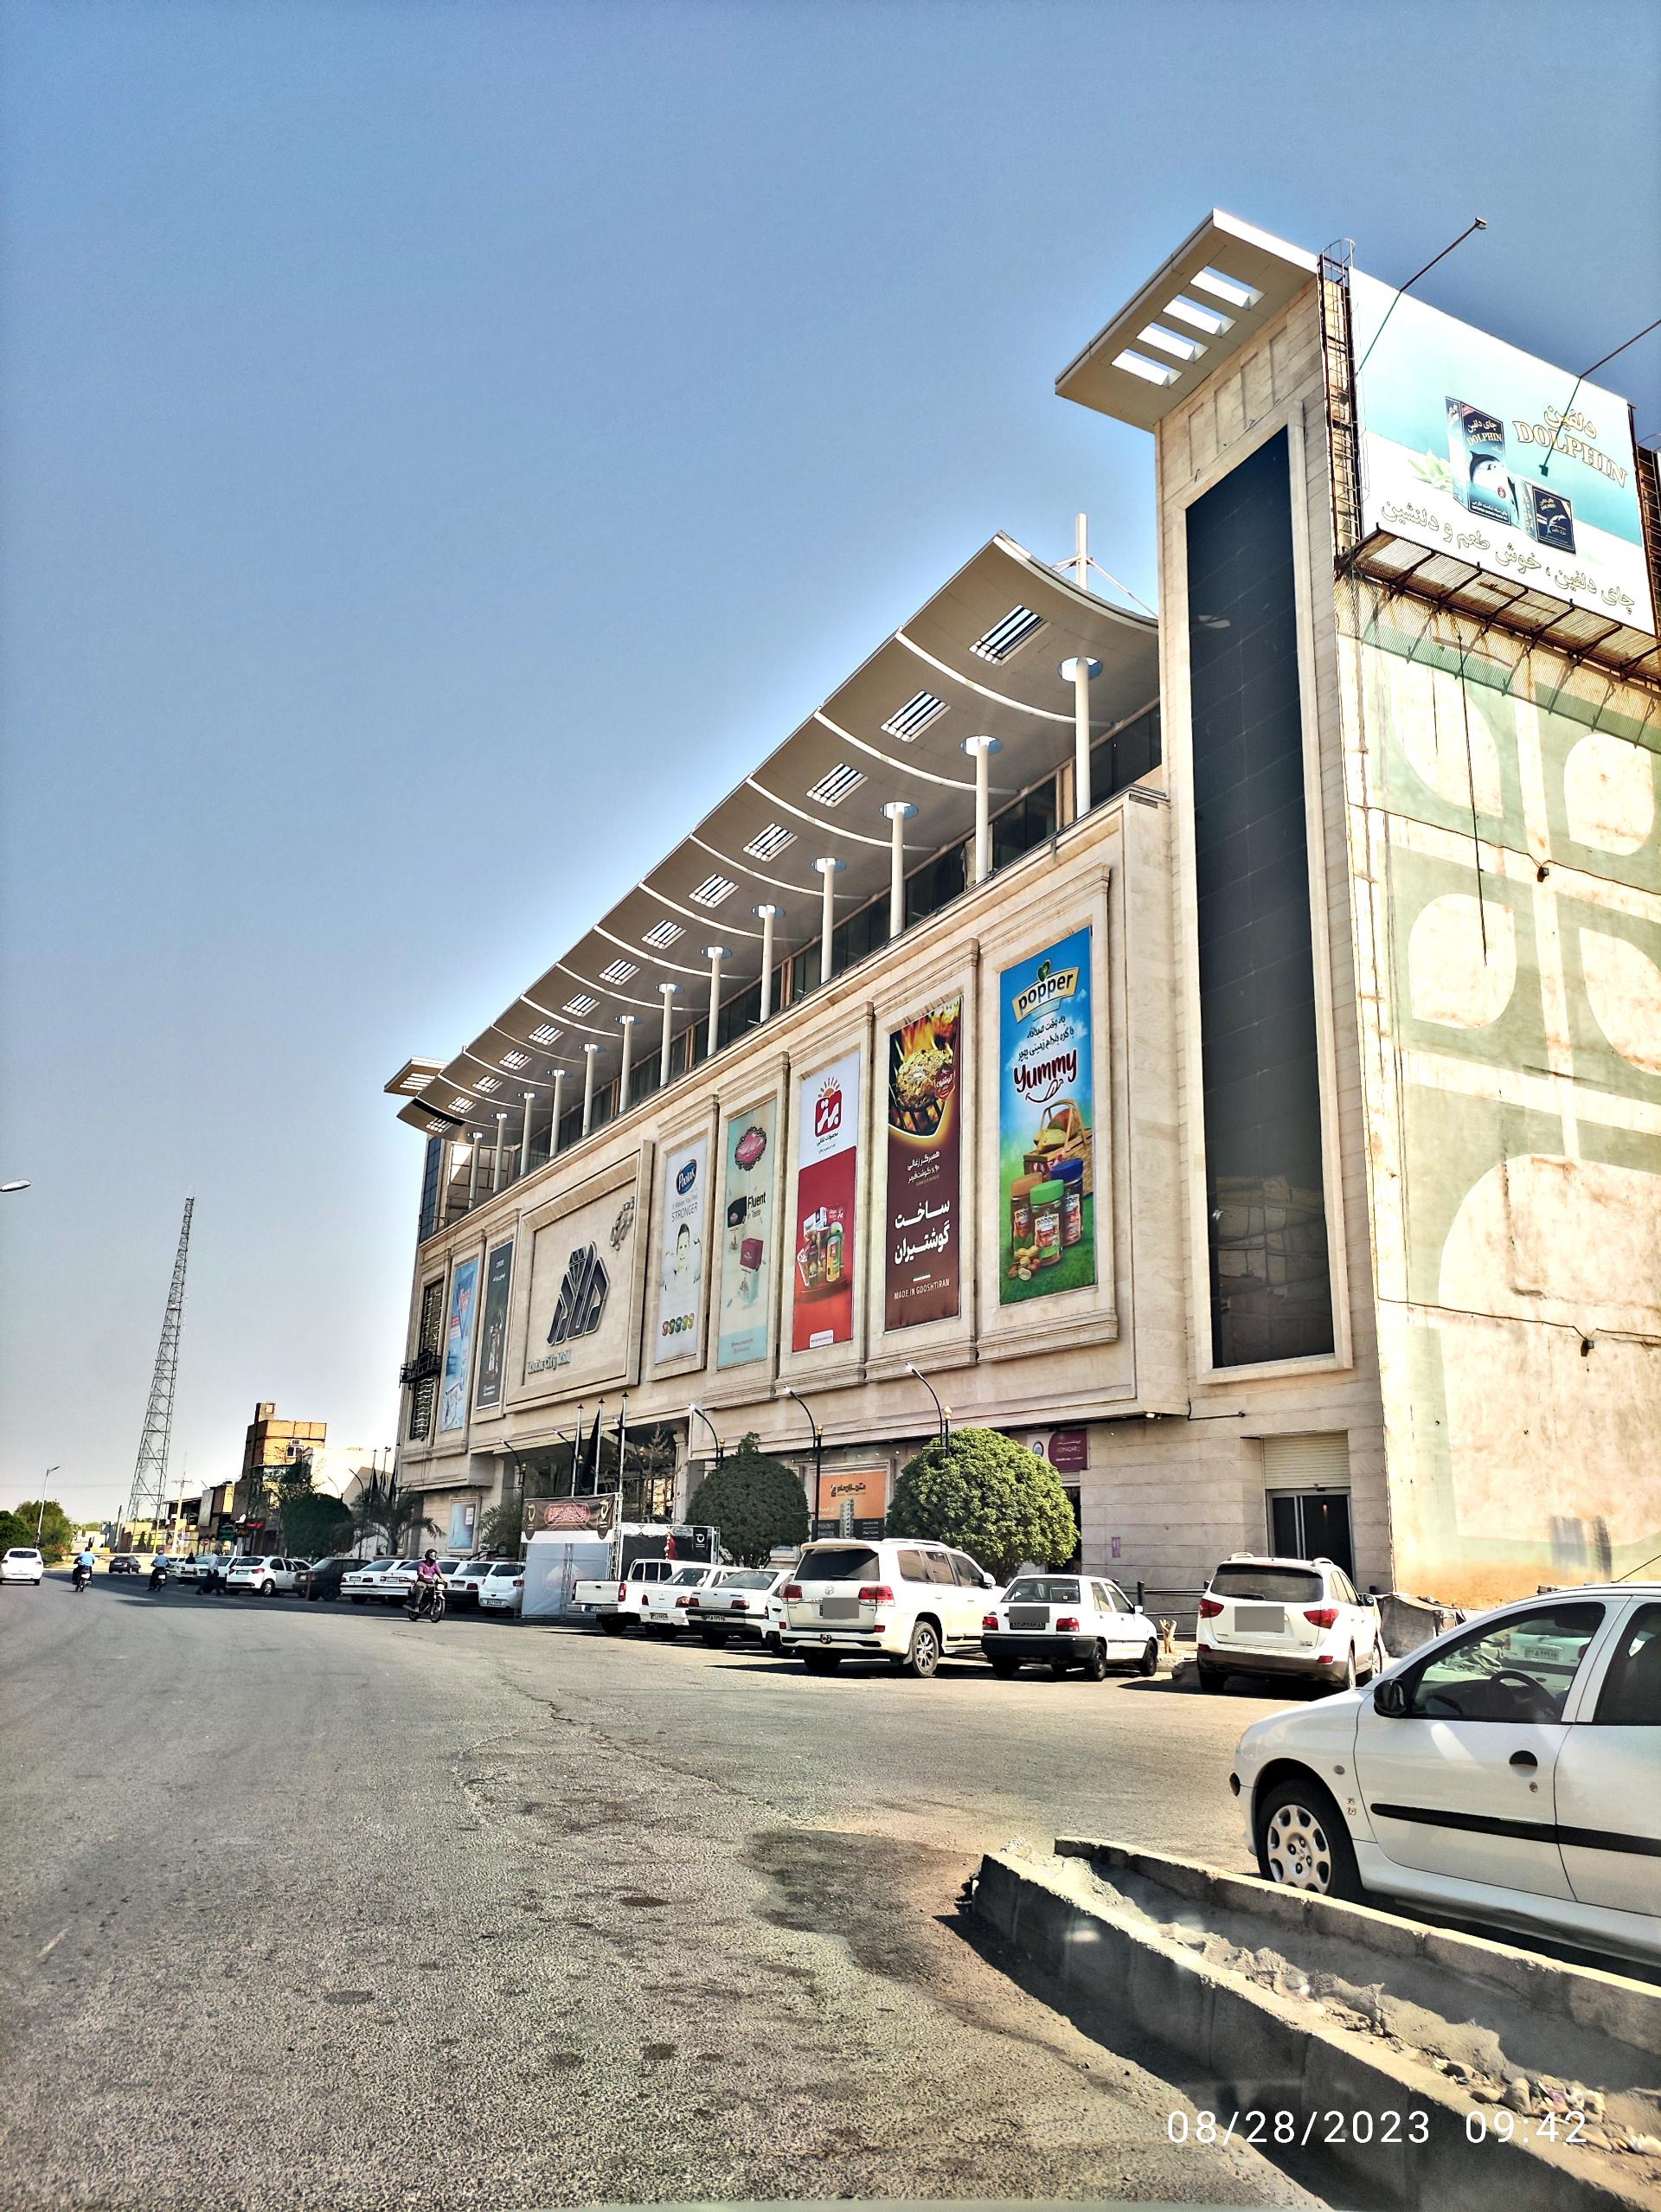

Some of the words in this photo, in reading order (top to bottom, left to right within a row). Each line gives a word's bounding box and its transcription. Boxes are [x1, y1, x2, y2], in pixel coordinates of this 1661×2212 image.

[1544, 405, 1597, 439] دلفین
[1466, 432, 1503, 446] DOLPHIN
[1512, 421, 1628, 488] DOLPHIN
[1382, 500, 1440, 532] دلنشین
[1443, 523, 1453, 542] و
[1457, 530, 1491, 550] طعم
[1495, 542, 1542, 574] خوش
[1601, 587, 1635, 615] چای
[1017, 972, 1074, 1016] popper
[1013, 1048, 1077, 1093] Yummy
[671, 1202, 698, 1223] STRONGER
[747, 1191, 766, 1209] Fluent
[895, 1199, 950, 1229] ساخت
[895, 1220, 950, 1265] گوشتیران
[894, 1287, 909, 1299] MADE
[909, 1286, 915, 1297] IN
[915, 1278, 950, 1295] GOOSHTIRAN
